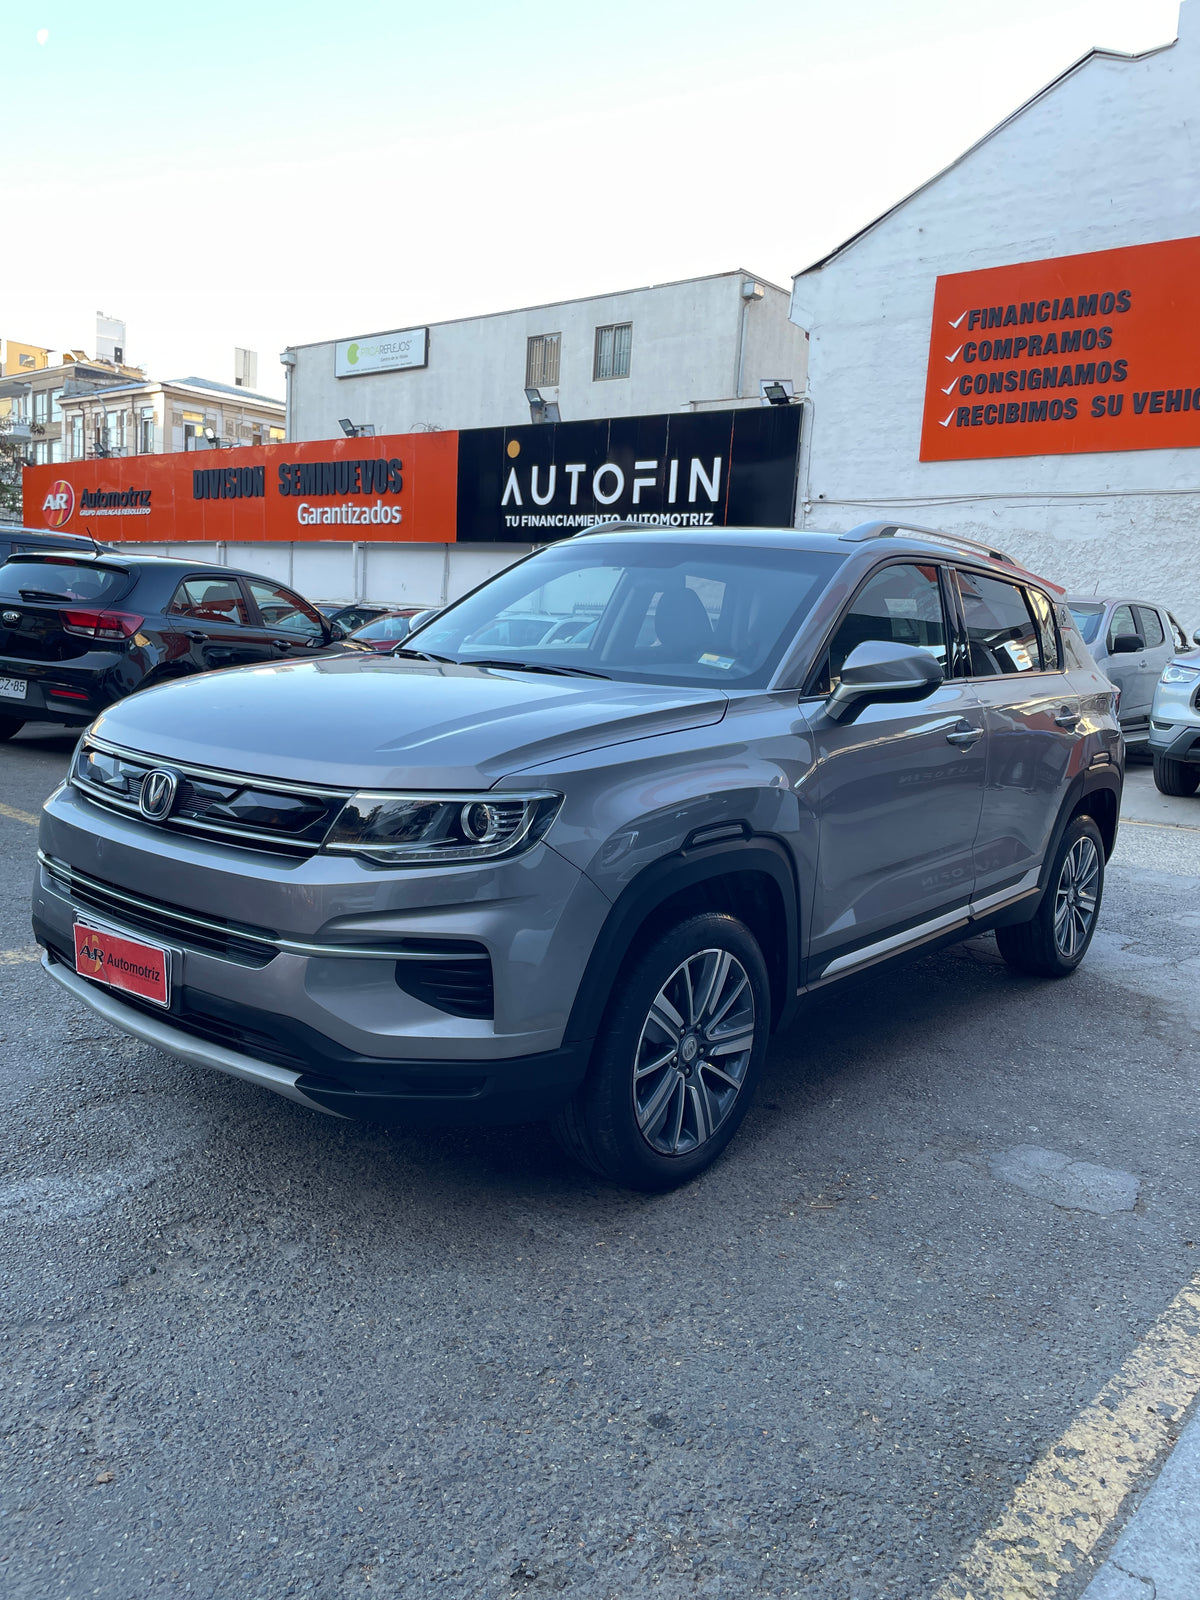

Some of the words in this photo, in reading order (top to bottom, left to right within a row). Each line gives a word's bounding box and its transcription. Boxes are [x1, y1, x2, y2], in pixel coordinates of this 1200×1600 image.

[967, 289, 1132, 331] FINANCIAMOS
[963, 326, 1113, 363] COMPRAMOS
[958, 359, 1128, 396] CONSIGNAMOS
[956, 397, 1078, 427] RECIBIMOS
[1090, 394, 1124, 417] SU
[193, 465, 265, 499] DIVISION
[278, 458, 403, 496] SEMINUEVOS
[501, 457, 722, 506] AUTOFIN
[80, 486, 151, 508] Automotriz
[298, 500, 402, 525] Garantizados
[505, 515, 519, 527] TU
[521, 514, 620, 527] FINANCIAMIENTO
[625, 513, 714, 526] AUTOMOTRIZ
[106, 953, 160, 982] Automotriz
